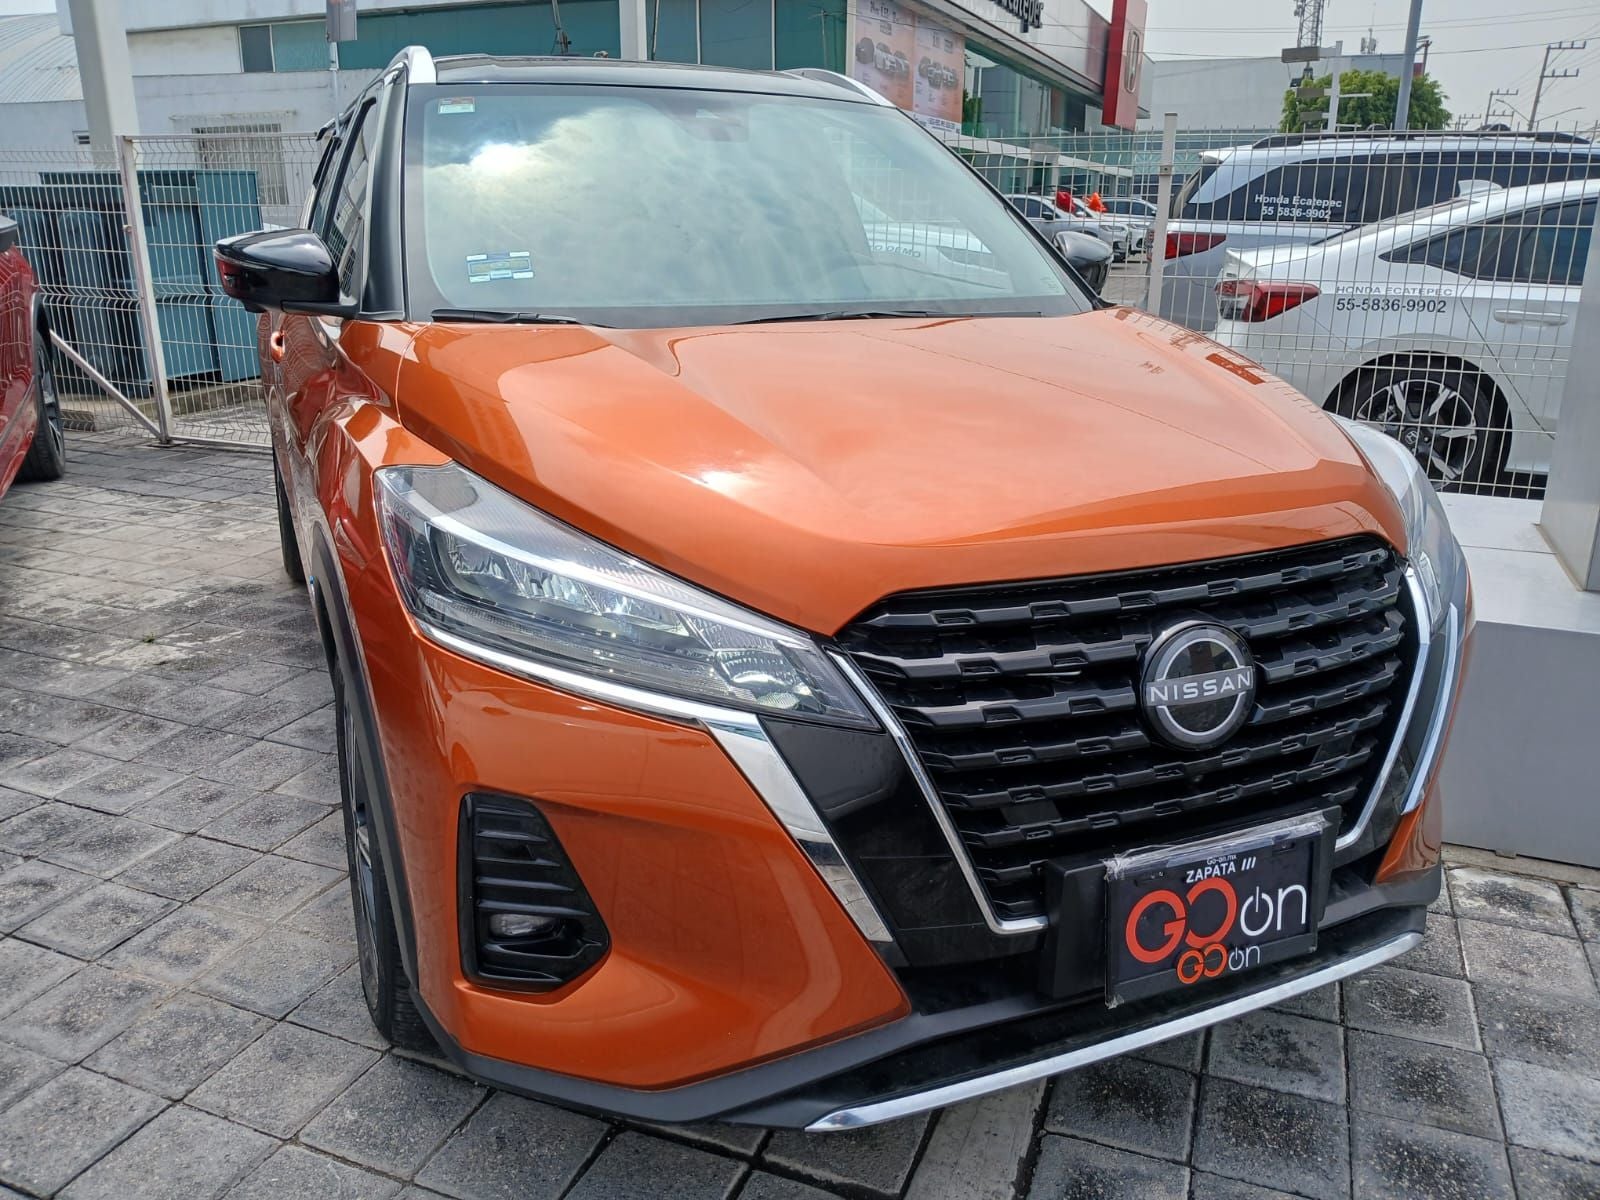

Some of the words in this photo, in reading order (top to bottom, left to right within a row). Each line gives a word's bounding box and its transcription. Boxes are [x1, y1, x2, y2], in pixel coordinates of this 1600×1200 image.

[1254, 194, 1289, 205] Honda
[1292, 195, 1342, 208] Ecatepec
[1261, 206, 1274, 216] 55
[1278, 206, 1331, 219] 5836-9902
[1336, 286, 1381, 294] HONDA
[1386, 286, 1453, 296] ECATEPEC
[1336, 298, 1447, 313] 55-5836-9902
[1150, 671, 1251, 702] NISSAN
[1186, 862, 1236, 883] ZAPATA
